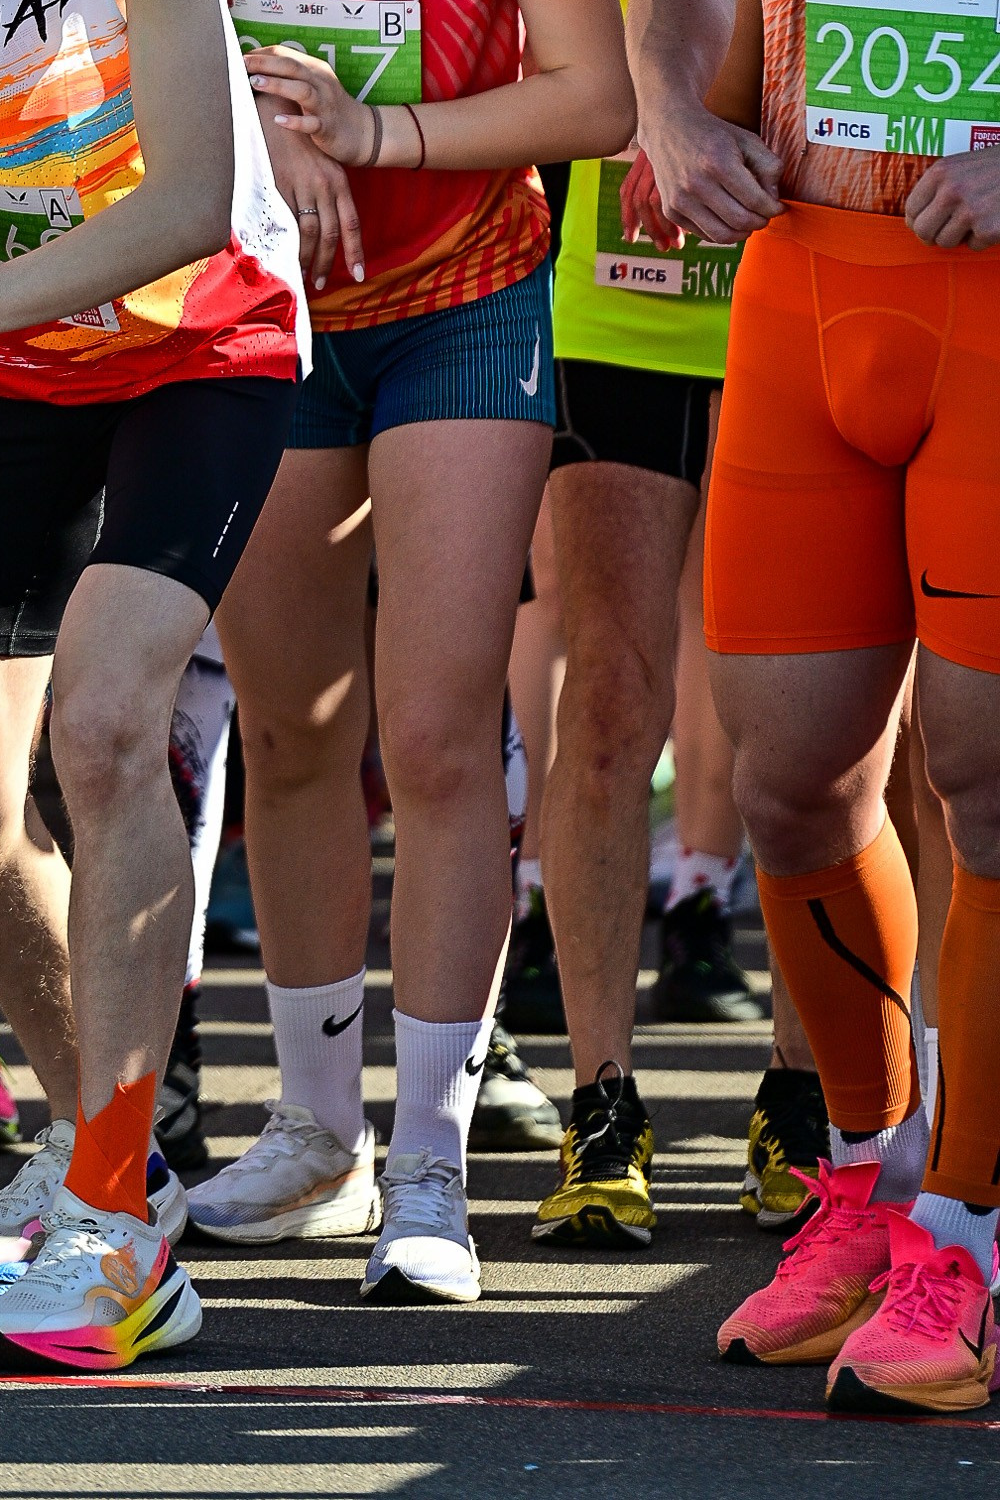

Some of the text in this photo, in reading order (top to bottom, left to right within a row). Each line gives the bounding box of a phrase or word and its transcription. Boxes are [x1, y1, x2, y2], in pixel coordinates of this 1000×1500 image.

[384, 12, 402, 37] B
[837, 122, 871, 139] ПСБ
[886, 115, 946, 156] 5KM
[50, 198, 68, 221] A
[632, 266, 667, 283] ПСБ
